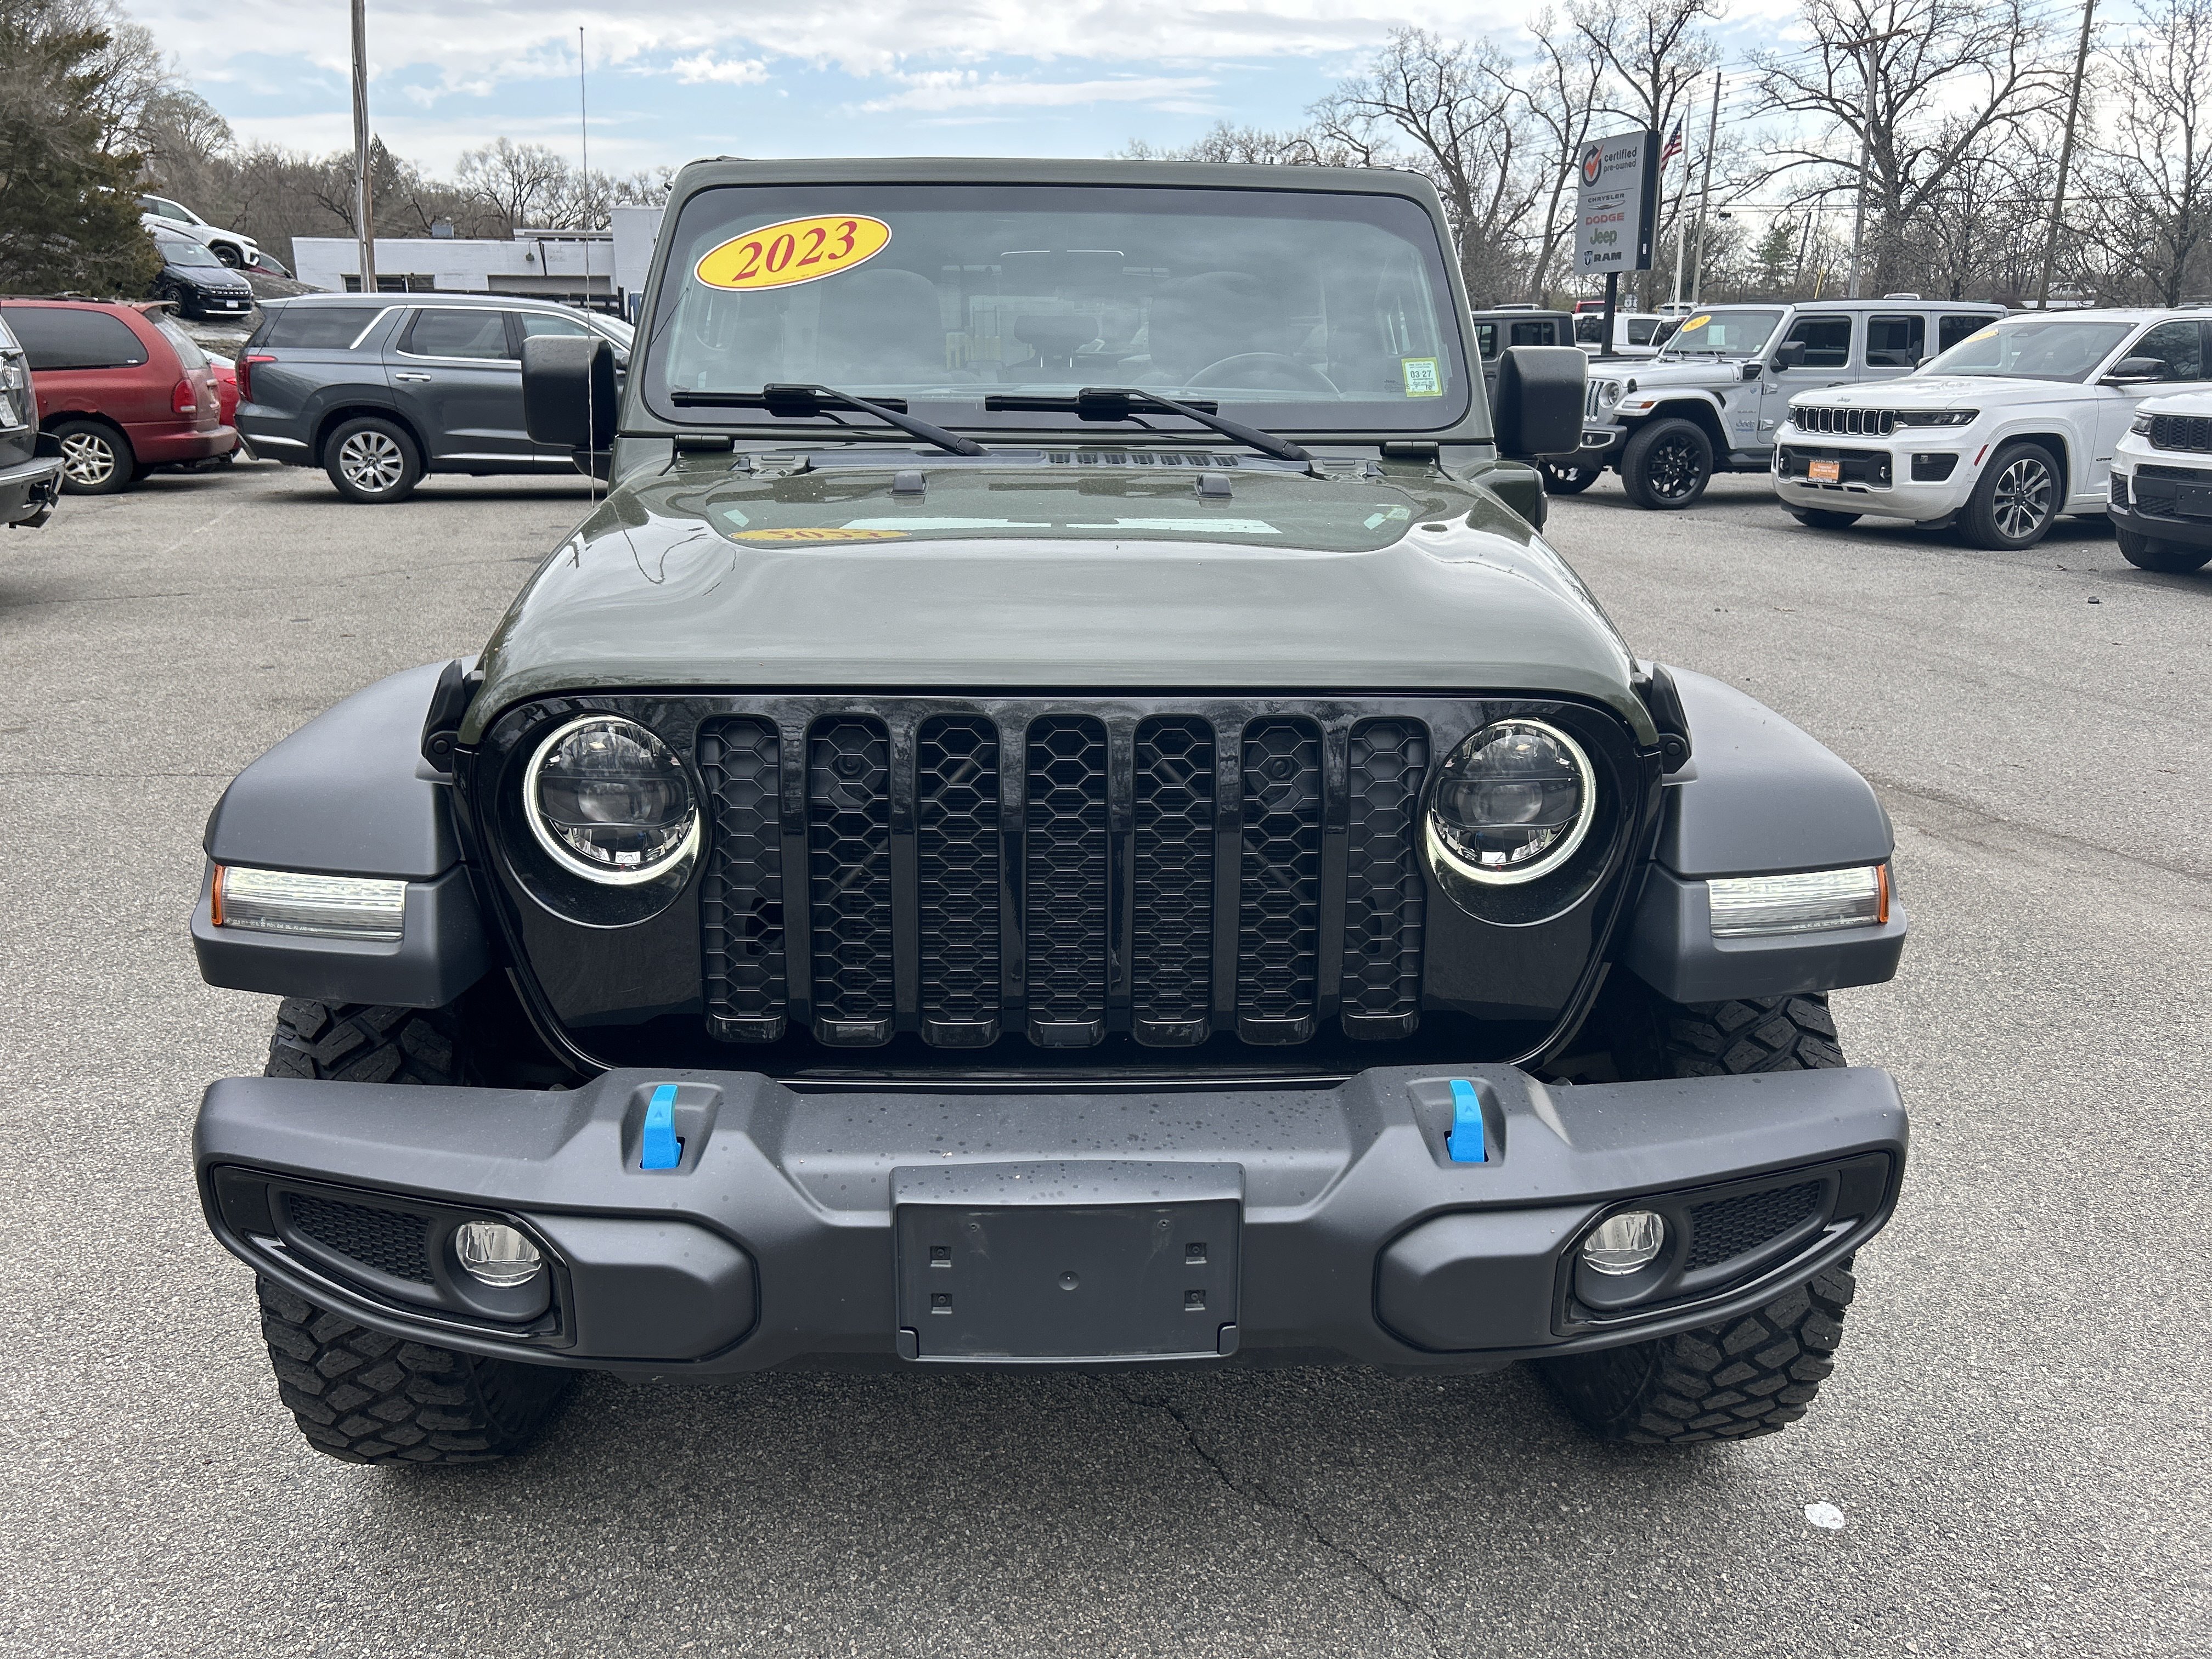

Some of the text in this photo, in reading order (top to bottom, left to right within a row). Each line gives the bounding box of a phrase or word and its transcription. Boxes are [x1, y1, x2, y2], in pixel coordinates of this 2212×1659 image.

[1604, 146, 1637, 162] certified
[1603, 158, 1637, 174] pre-owned
[1588, 193, 1624, 203] CHRYSLER
[1585, 212, 1624, 225] DODGE
[1590, 228, 1617, 246] Jeep
[732, 221, 857, 281] 2023
[1594, 252, 1622, 262] RAM
